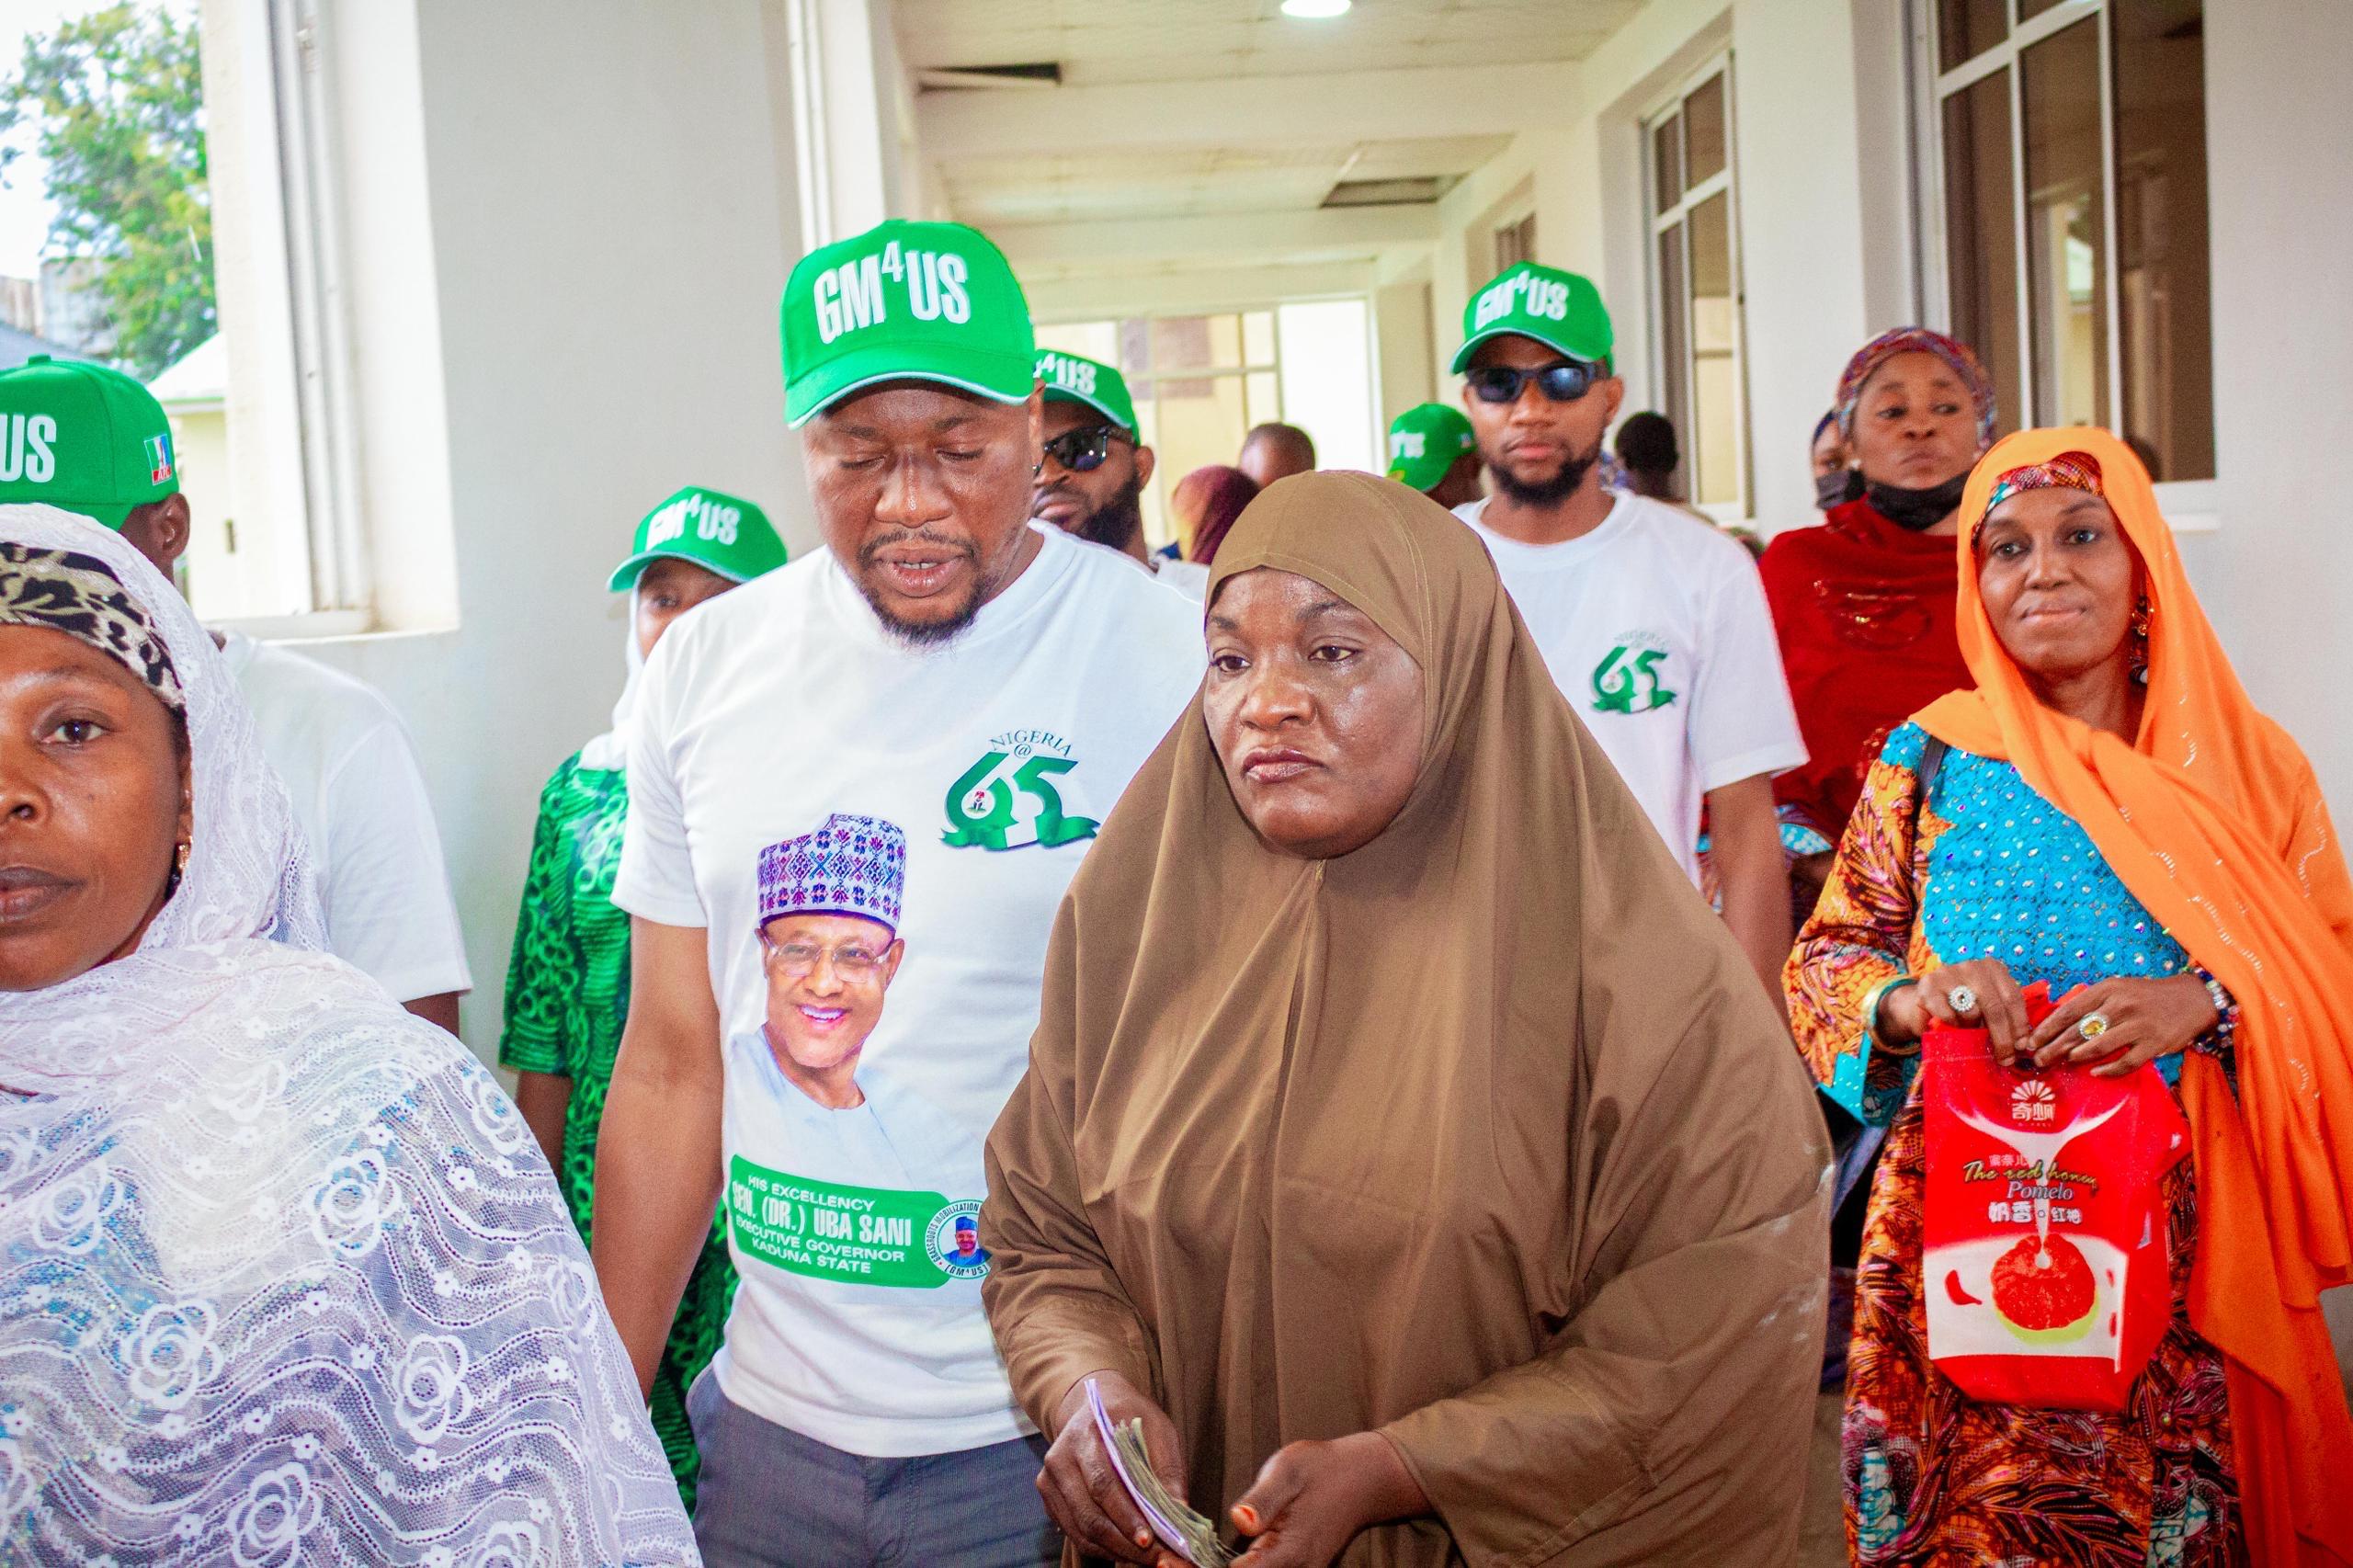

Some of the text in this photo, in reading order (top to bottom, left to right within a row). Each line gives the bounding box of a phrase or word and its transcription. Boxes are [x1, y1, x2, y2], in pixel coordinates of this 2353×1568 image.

[0, 414, 57, 483] US
[1590, 646, 1671, 714] 65
[990, 729, 1073, 757] NIGERIA
[1014, 743, 1032, 758] @
[943, 751, 1081, 850] 65
[1963, 1160, 1999, 1183] The
[2003, 1159, 2044, 1180] red
[748, 1175, 875, 1211] HIS EXCELLENCY
[2007, 1180, 2074, 1200] Pomelo
[762, 1196, 805, 1235] (DR.)
[813, 1208, 852, 1241] UBA
[858, 1214, 912, 1246] SANI
[934, 1202, 980, 1225] MOBILIZATION
[736, 1214, 905, 1262] EXECUTIVE GOVERNOR
[752, 1236, 871, 1274] KADUNA STATE
